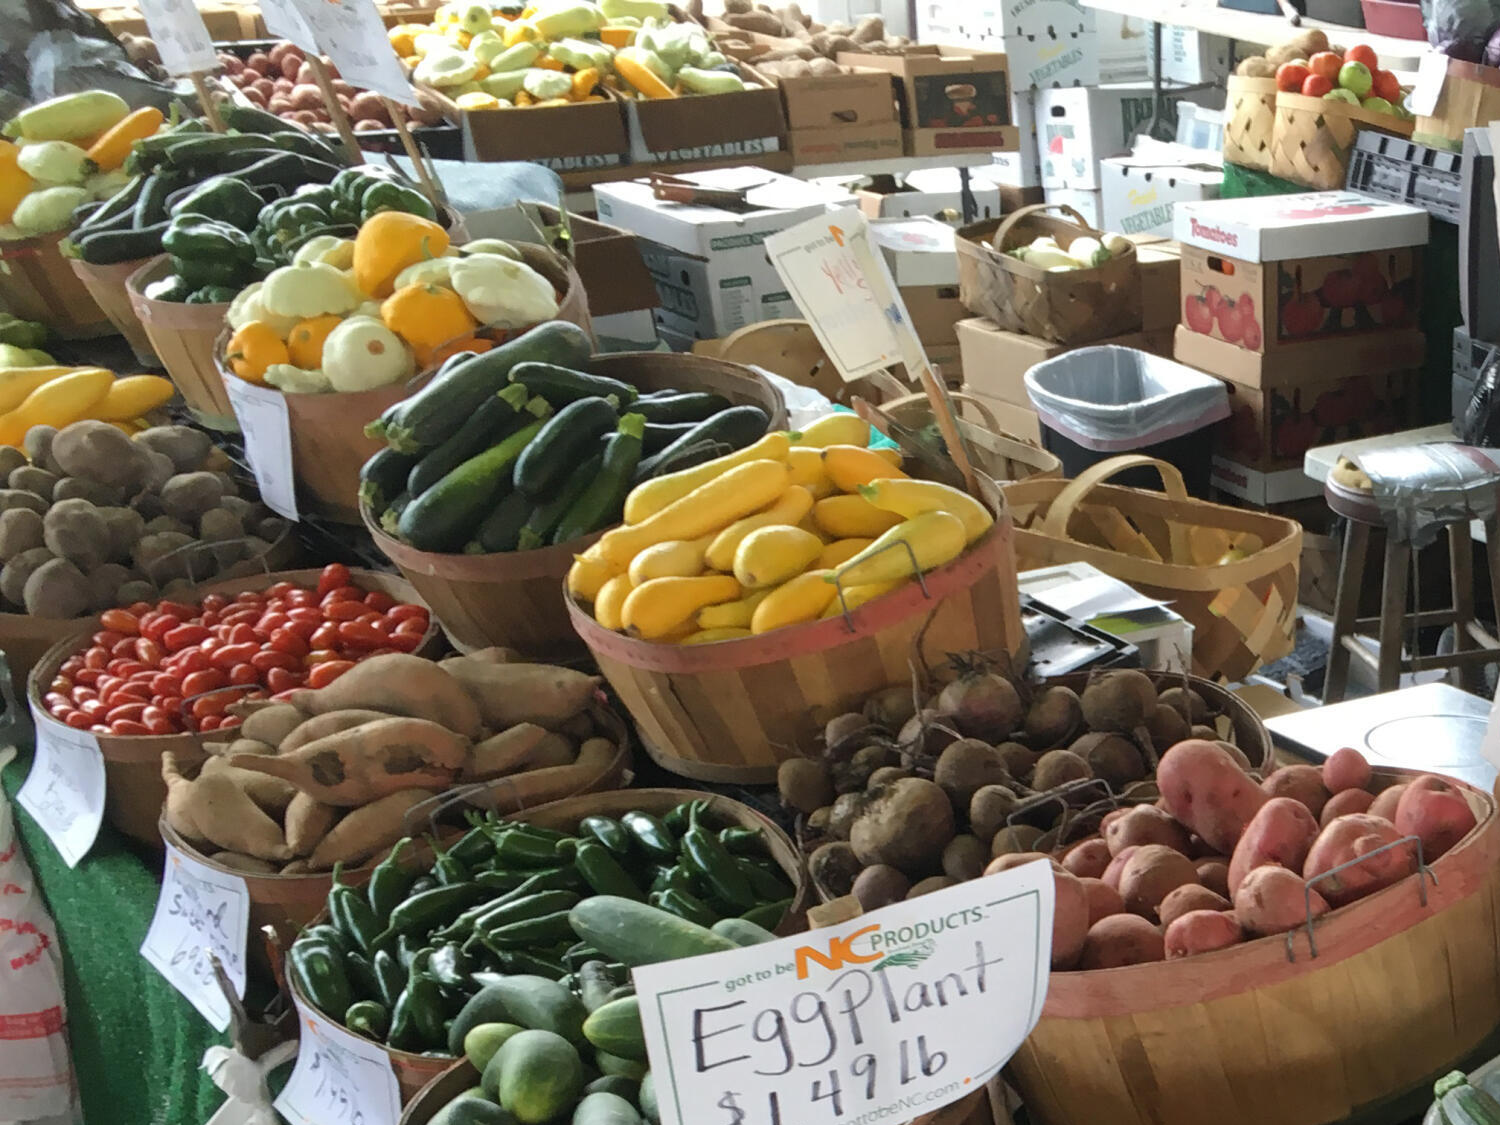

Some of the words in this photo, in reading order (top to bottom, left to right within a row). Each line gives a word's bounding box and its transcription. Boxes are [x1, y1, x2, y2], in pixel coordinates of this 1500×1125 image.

[723, 972, 753, 993] got
[755, 968, 772, 983] to
[774, 960, 796, 979] be
[794, 924, 885, 980] NC
[870, 907, 984, 951] PRODUCTS
[899, 1034, 949, 1086] lb
